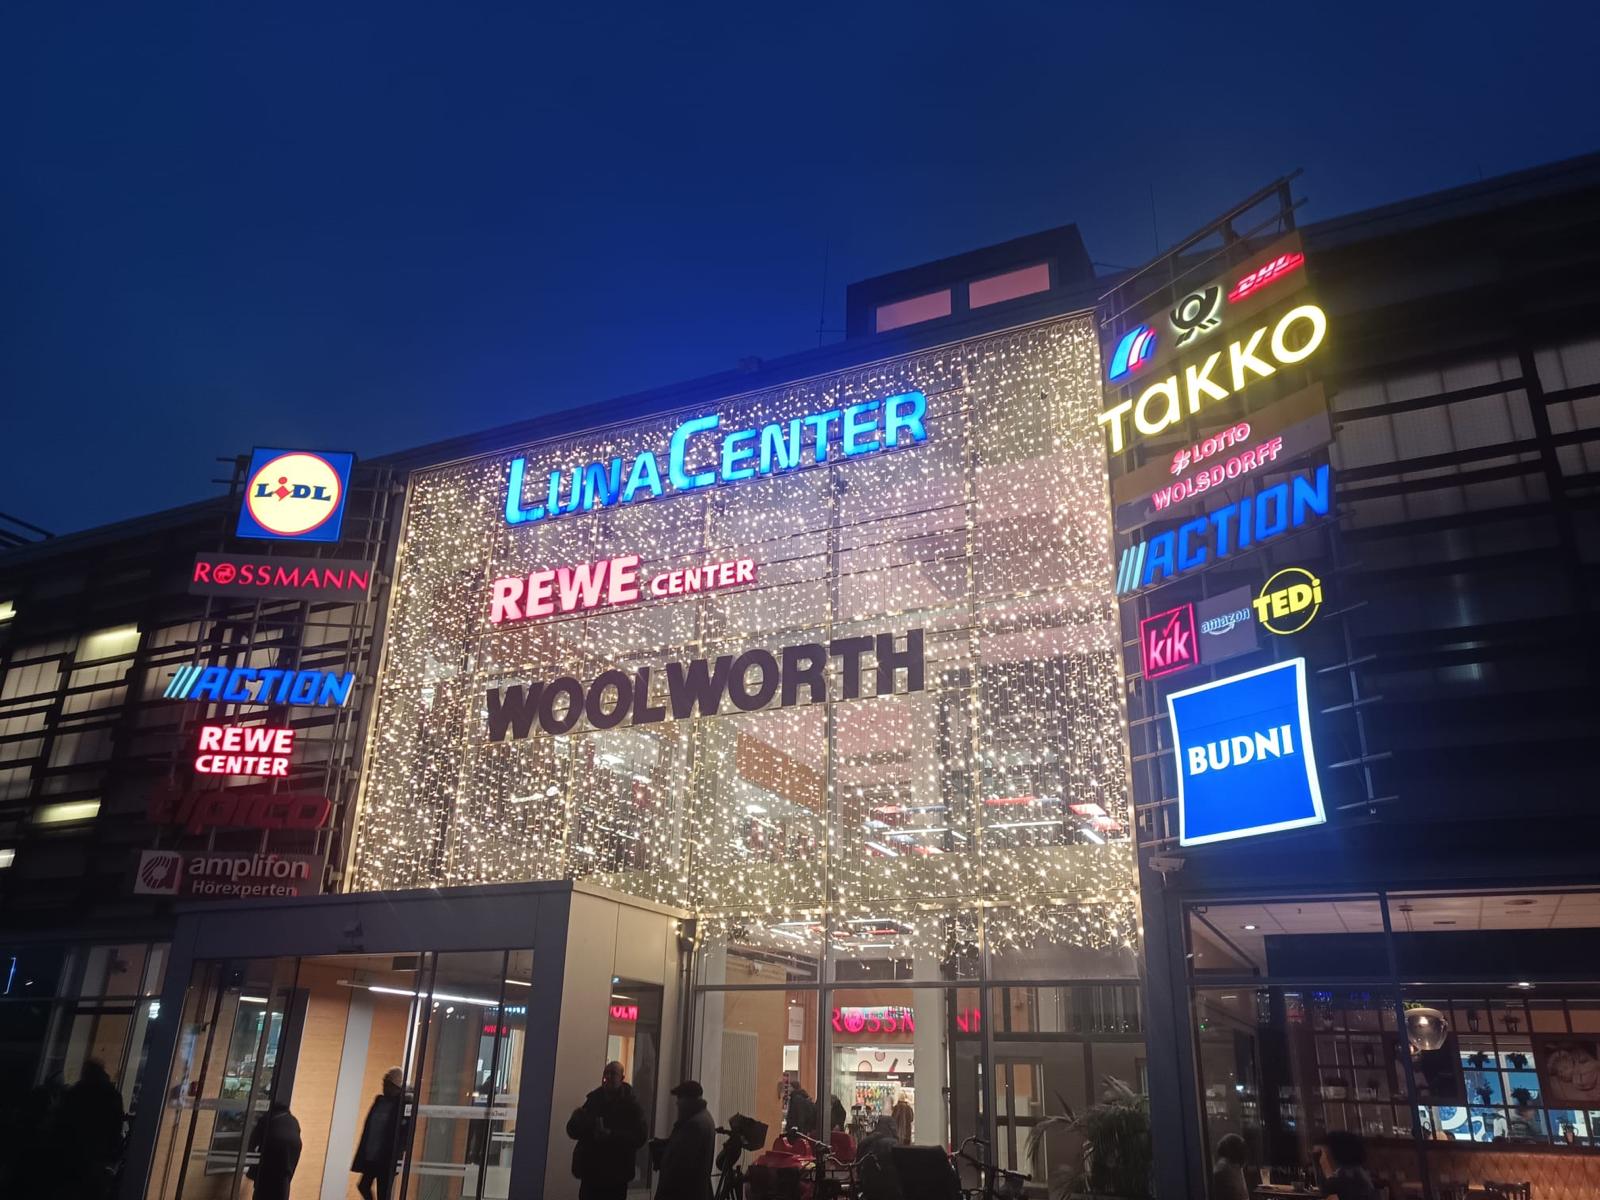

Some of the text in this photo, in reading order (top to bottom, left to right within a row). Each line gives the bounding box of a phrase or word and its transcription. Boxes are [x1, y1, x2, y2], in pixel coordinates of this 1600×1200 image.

[1236, 253, 1293, 295] DHL
[1193, 422, 1251, 464] LOTTO
[1152, 436, 1283, 511] WOLSDORFF
[1142, 464, 1330, 586] ACTION
[193, 561, 368, 591] ROSSMANN
[490, 555, 757, 625] REWE CENTER
[1201, 607, 1251, 634] amazon
[189, 666, 356, 708] ACTION
[486, 628, 926, 742] WOOLWORTH
[198, 725, 295, 755] REWE
[1188, 724, 1294, 776] BUDNI
[194, 754, 290, 777] CENTER
[188, 853, 310, 882] amplifon
[191, 878, 297, 899] Hörexperten
